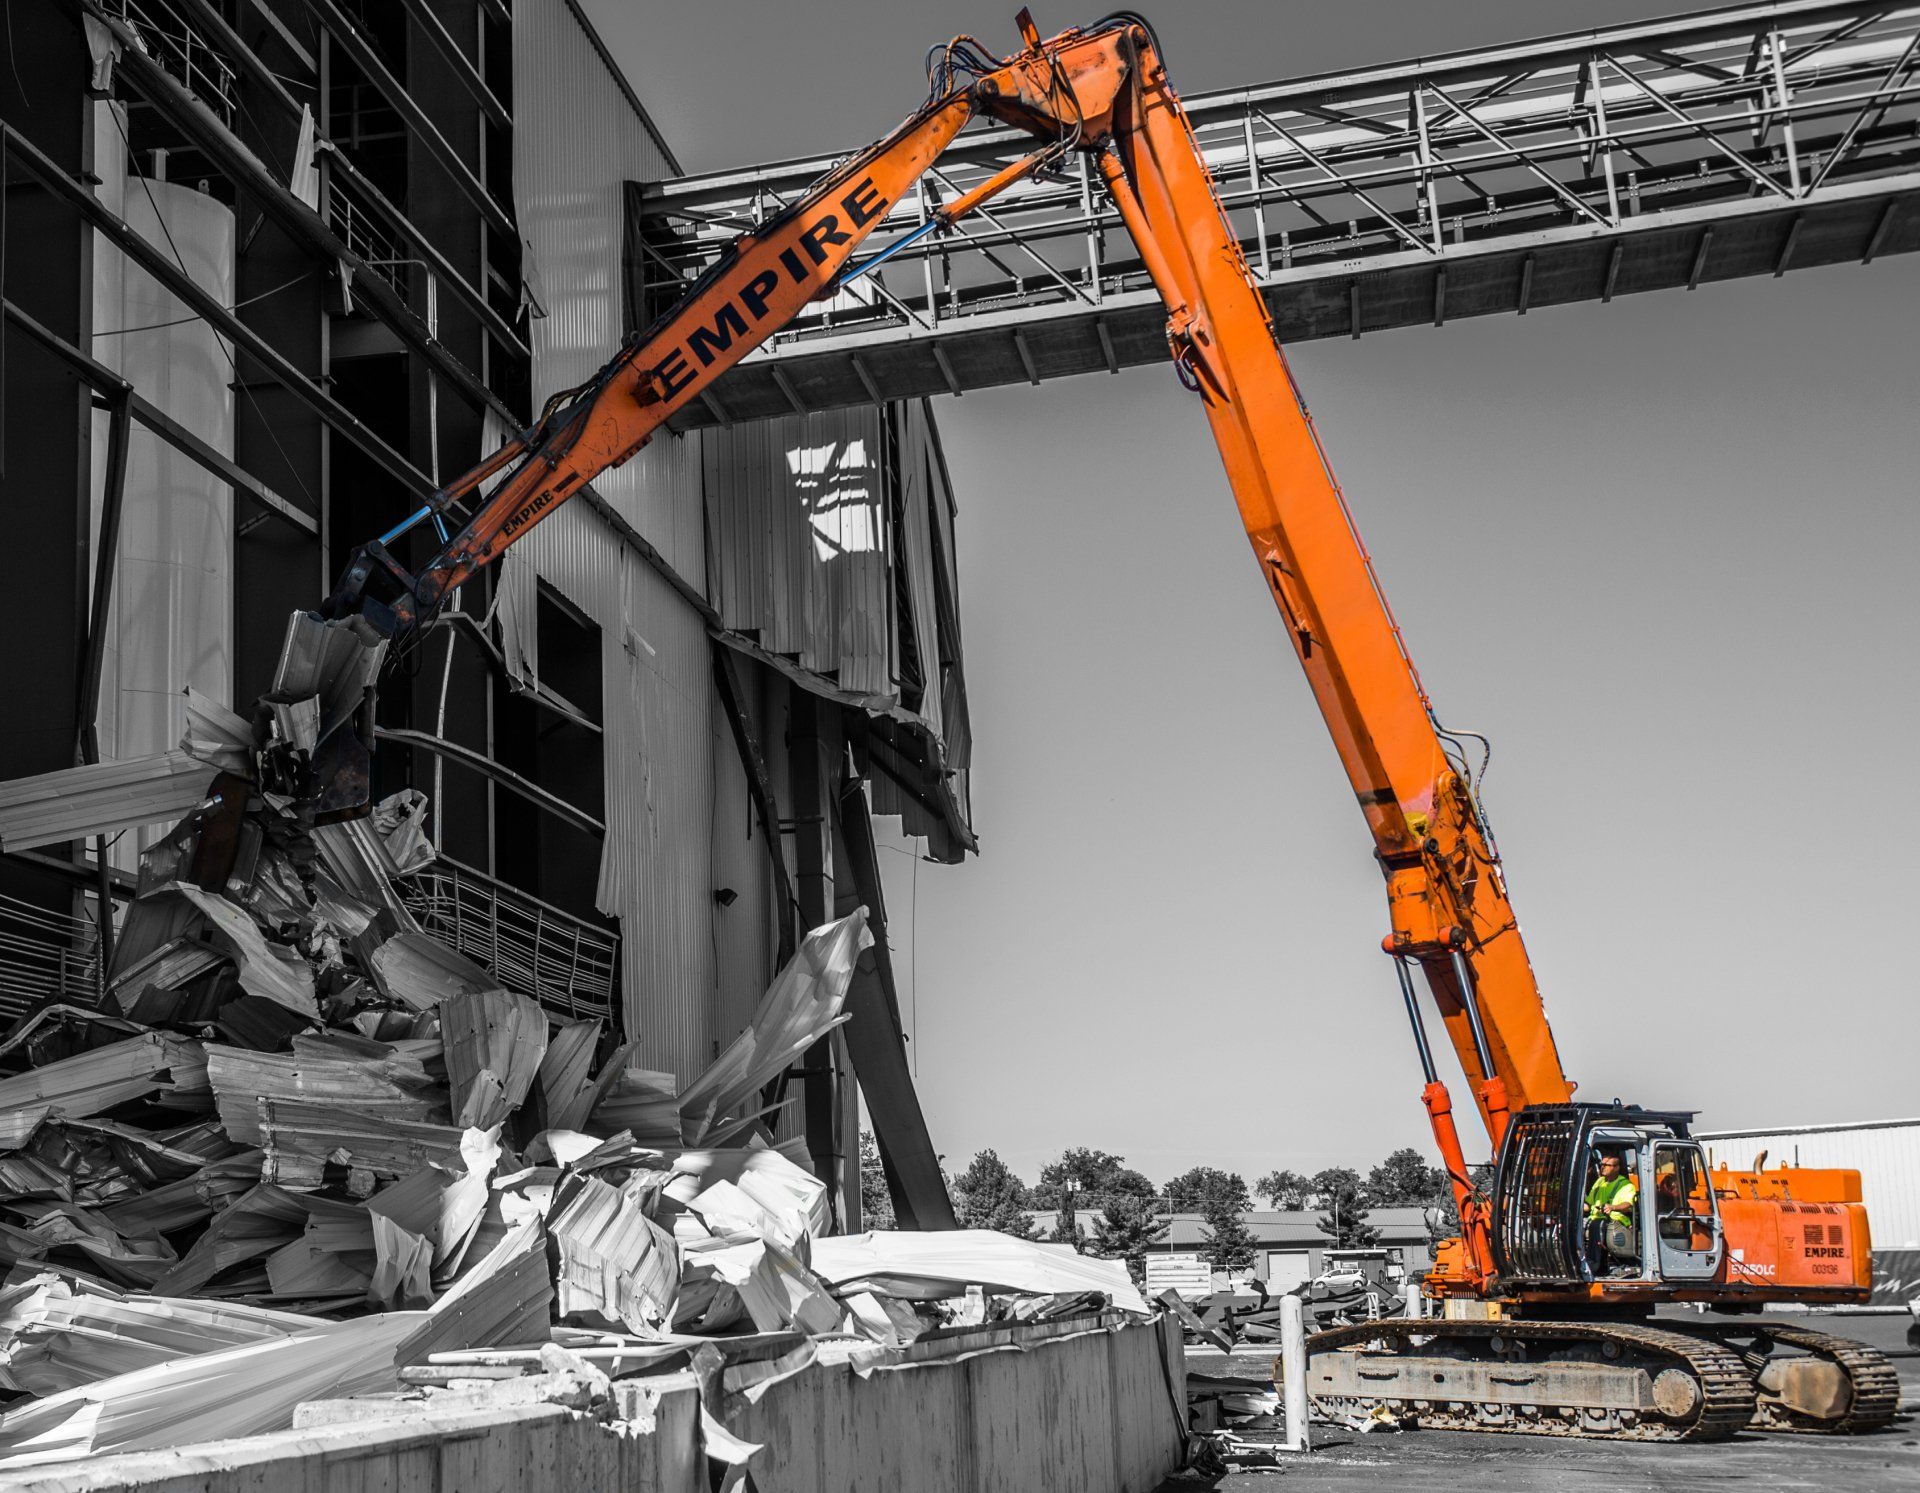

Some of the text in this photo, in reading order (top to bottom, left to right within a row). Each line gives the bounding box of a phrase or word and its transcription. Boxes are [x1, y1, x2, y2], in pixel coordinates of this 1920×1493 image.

[652, 177, 888, 403] EMPIRE
[502, 489, 553, 536] EMPIRE
[1804, 1247, 1845, 1258] EMPIRE
